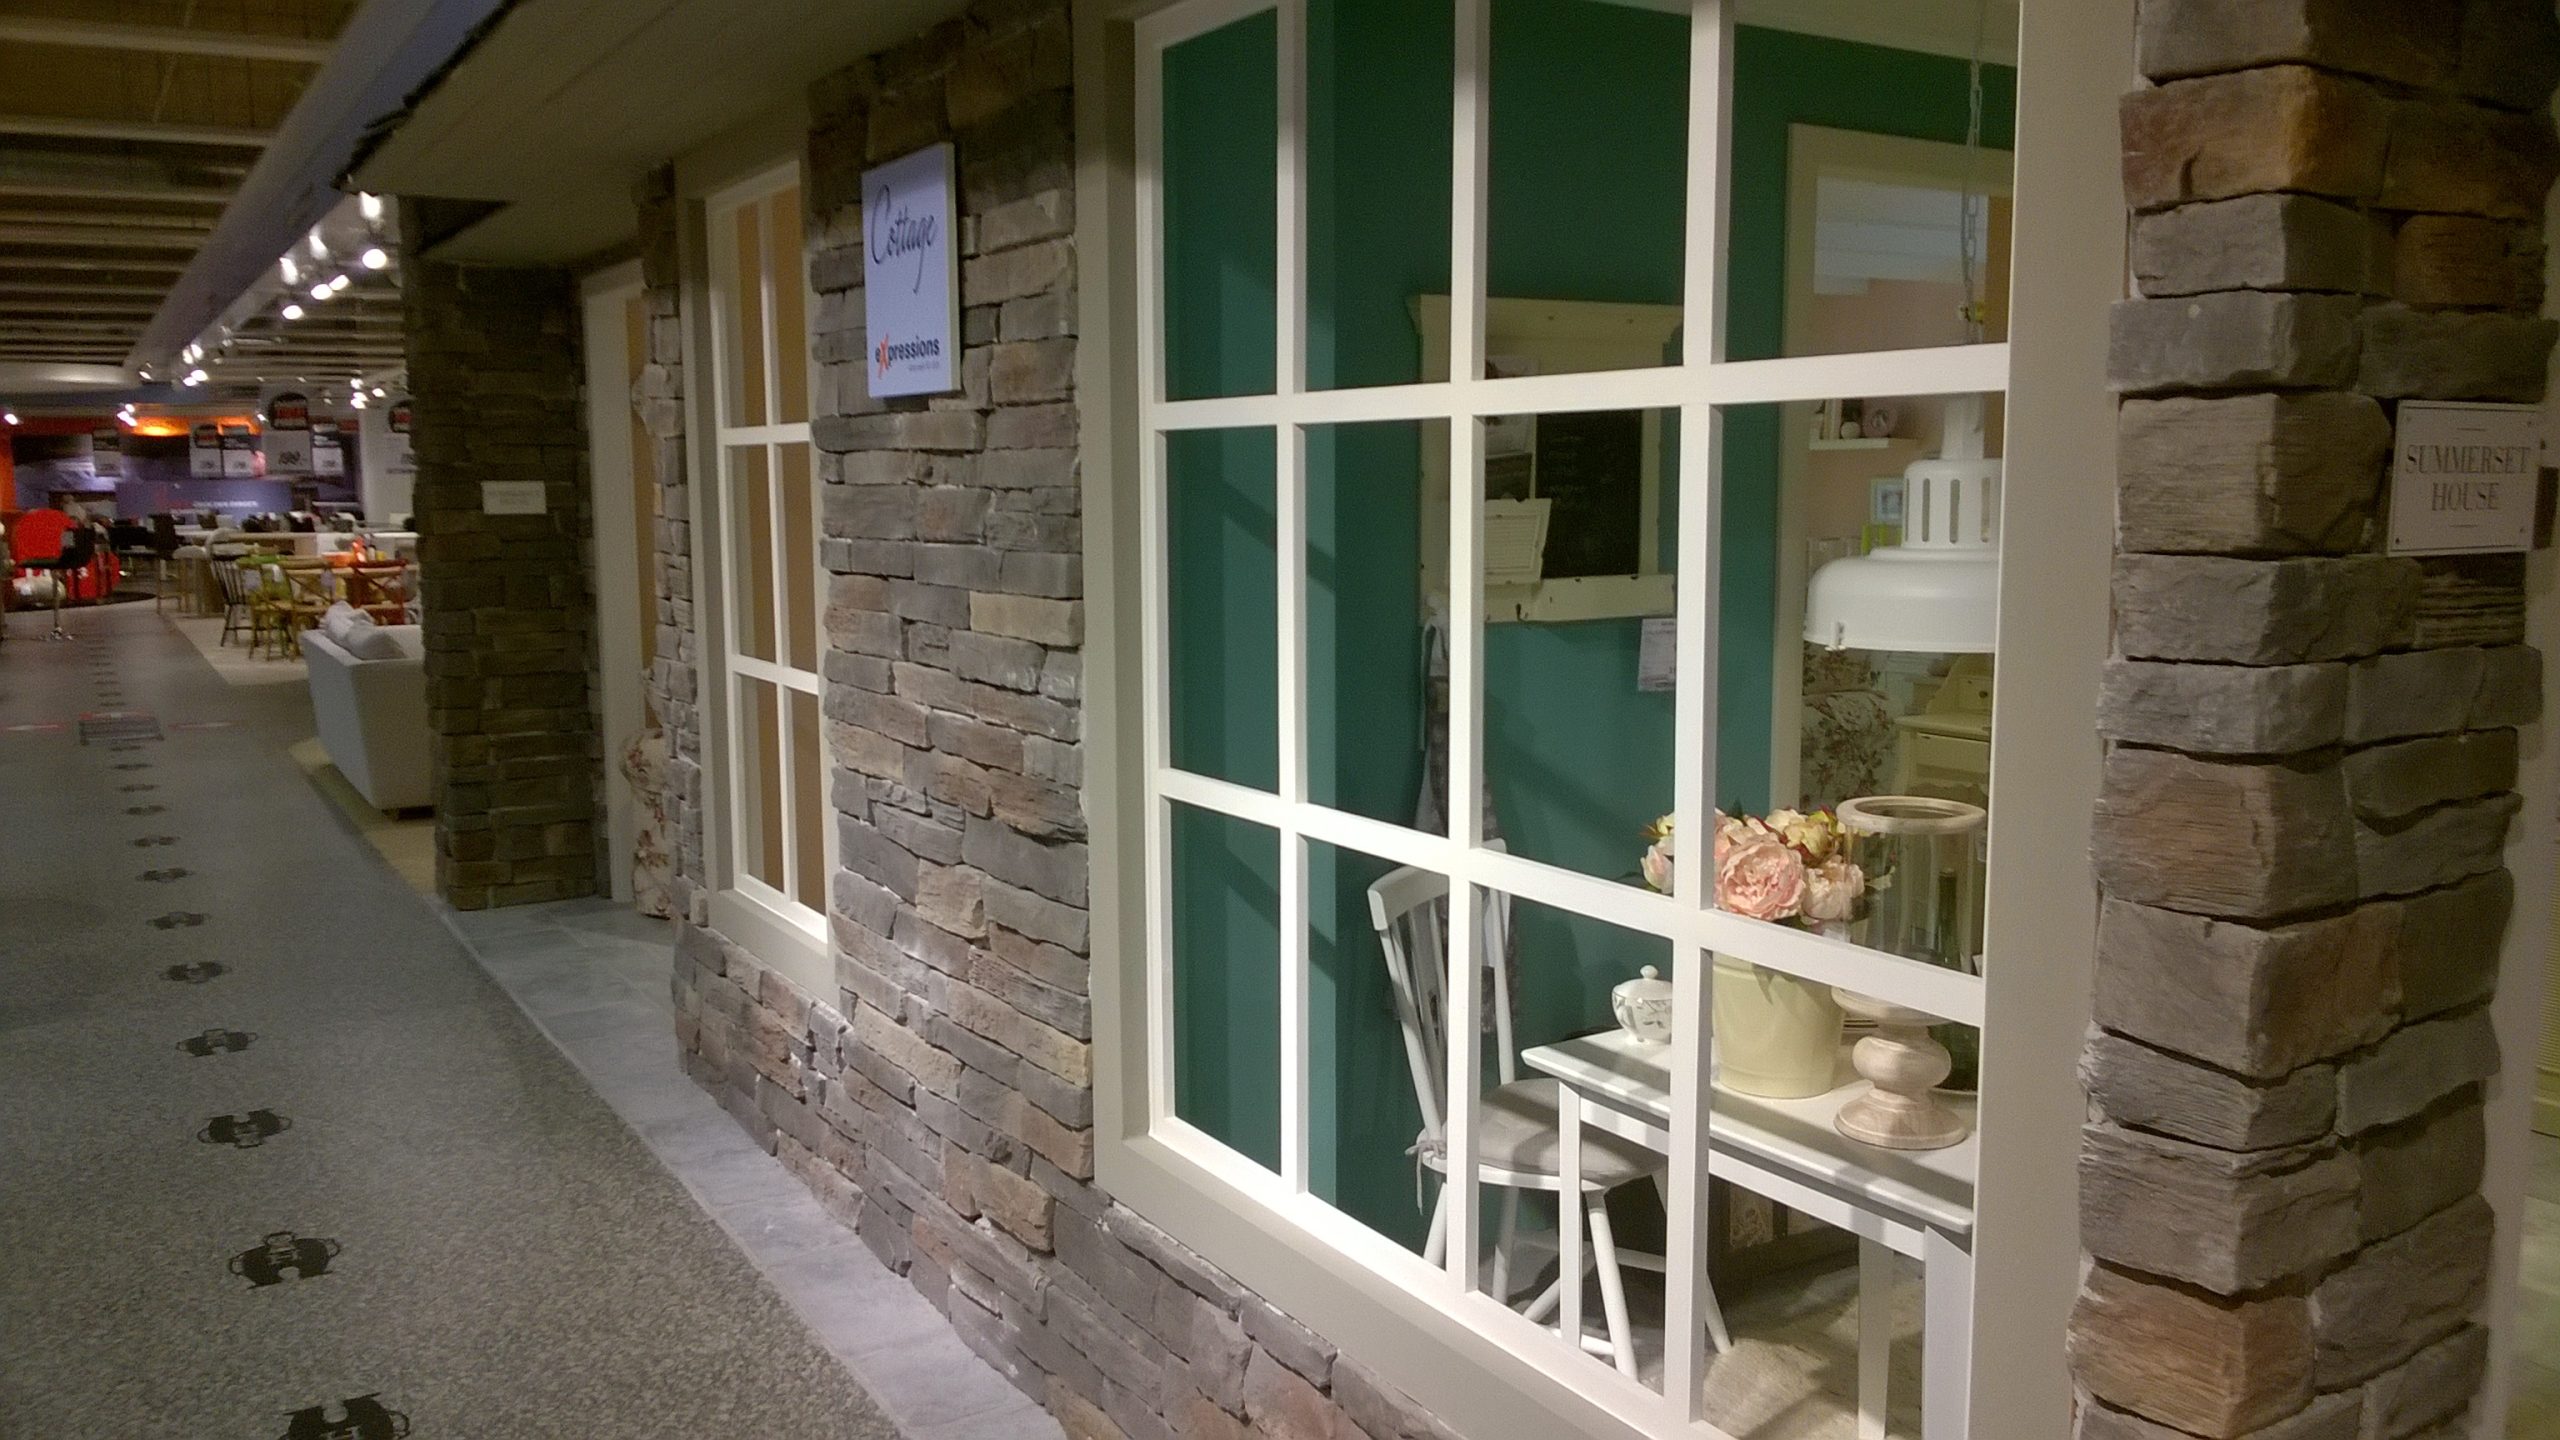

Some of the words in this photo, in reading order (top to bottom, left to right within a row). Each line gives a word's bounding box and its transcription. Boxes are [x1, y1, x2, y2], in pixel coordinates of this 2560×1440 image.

[871, 184, 938, 295] Cottage
[2405, 444, 2532, 475] SUMMERSET
[2431, 481, 2501, 512] HOUSE
